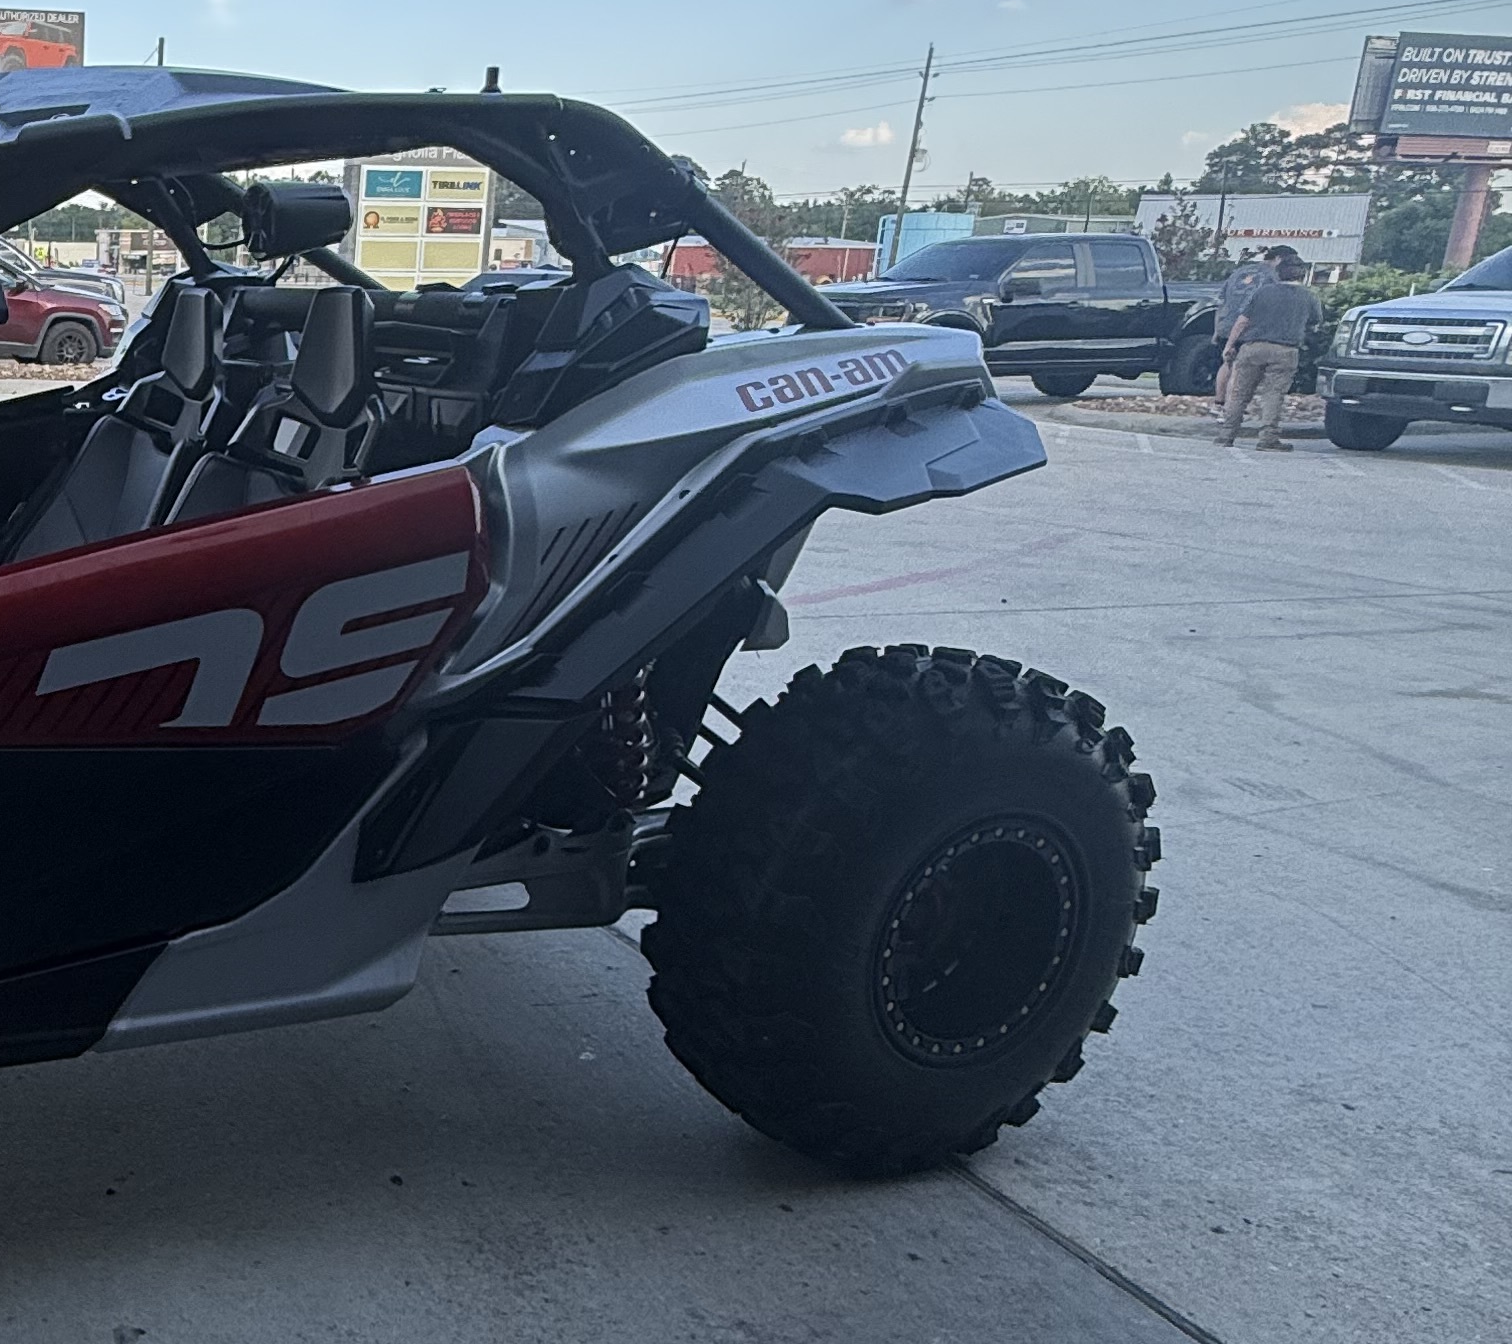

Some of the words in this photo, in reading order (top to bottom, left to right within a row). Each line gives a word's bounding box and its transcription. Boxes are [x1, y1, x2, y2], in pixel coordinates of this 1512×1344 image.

[47, 12, 80, 24] DEALER
[1400, 46, 1443, 62] BUILT
[1442, 47, 1467, 63] ON
[1465, 49, 1512, 66] TRUST.
[1397, 67, 1450, 84] DRIVEN
[1449, 69, 1472, 85] BY
[1469, 70, 1512, 86] STREN
[1433, 90, 1498, 103] FINANCIAL
[1252, 228, 1323, 237] BREWING
[735, 349, 911, 412] can-am
